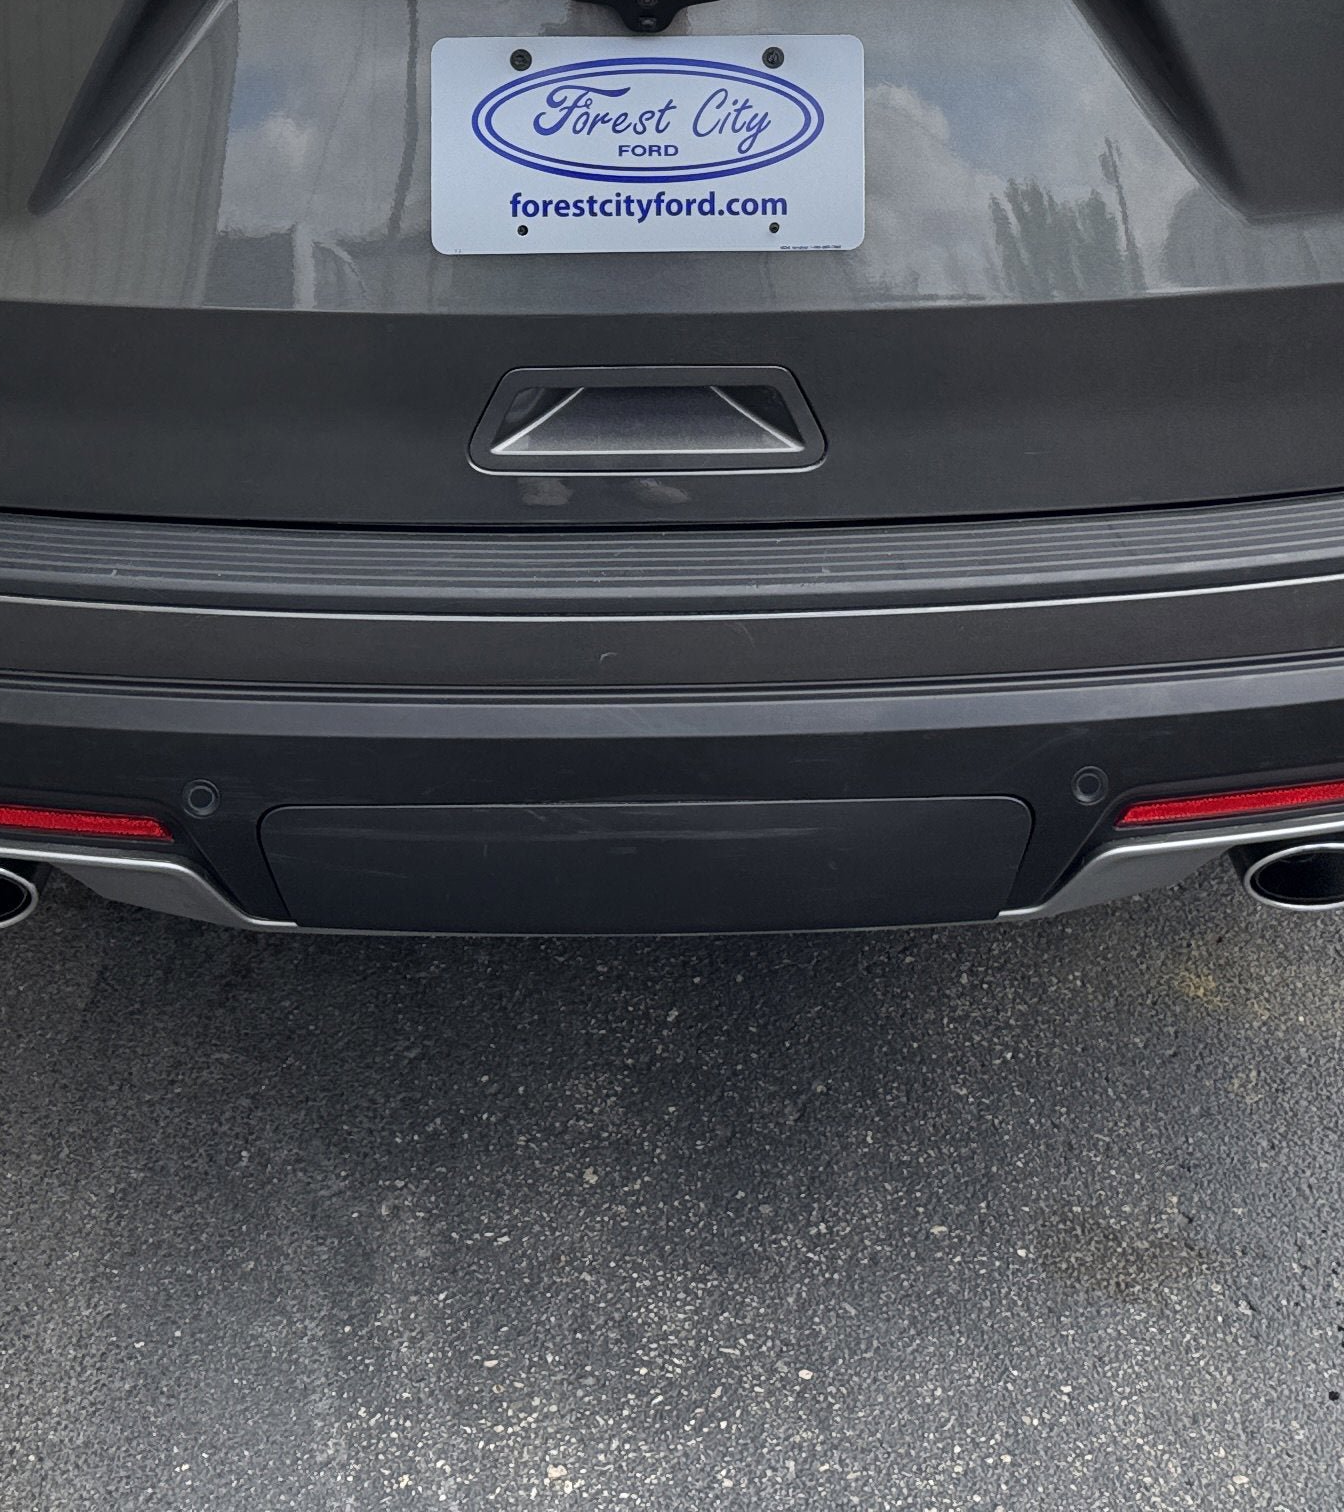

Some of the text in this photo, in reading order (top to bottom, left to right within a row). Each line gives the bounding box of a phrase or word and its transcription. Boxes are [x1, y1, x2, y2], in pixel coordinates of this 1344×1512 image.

[533, 85, 772, 155] Forest City
[617, 143, 680, 158] FORD
[510, 191, 788, 223] forestcityford.com
